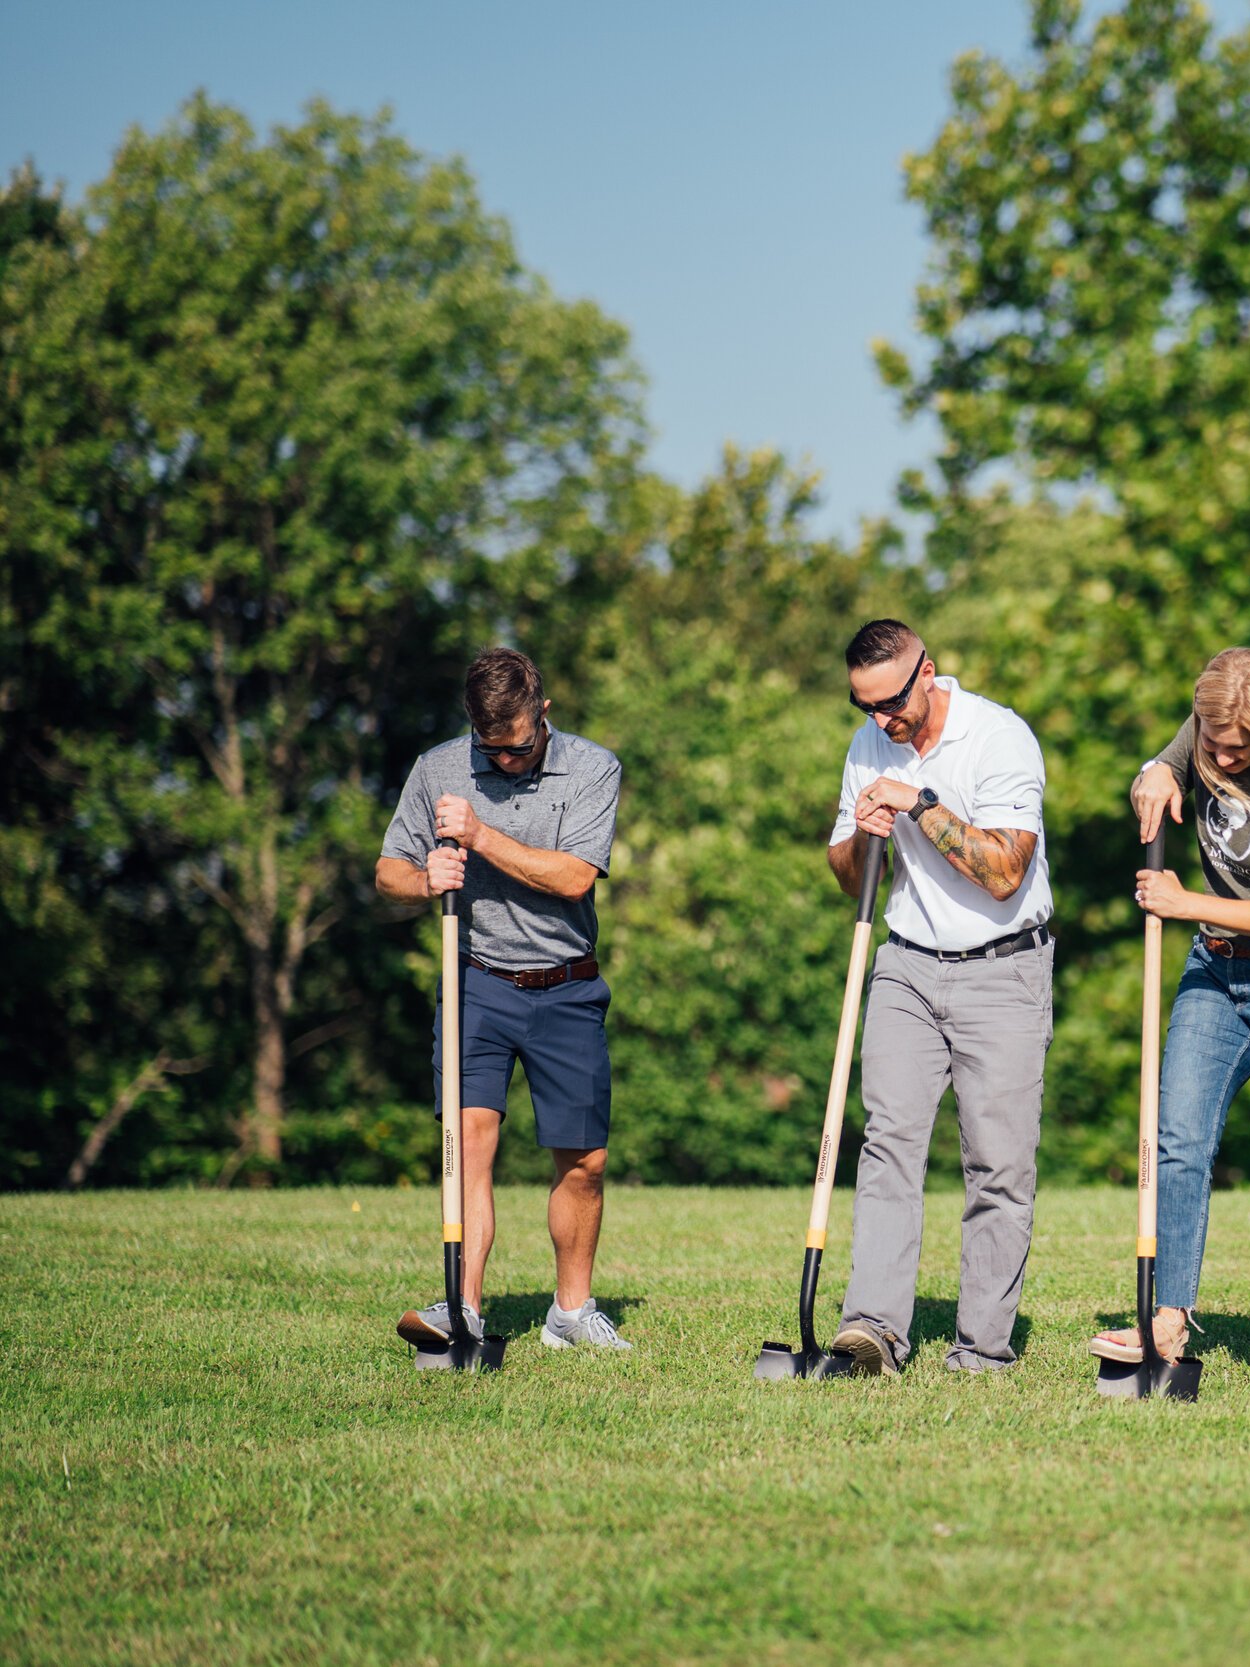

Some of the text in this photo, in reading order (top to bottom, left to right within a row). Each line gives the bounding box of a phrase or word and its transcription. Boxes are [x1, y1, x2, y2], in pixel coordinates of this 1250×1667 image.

[444, 1129, 453, 1177] YARDWORKS
[817, 1134, 831, 1183] YARDWORKS
[1140, 1138, 1149, 1189] YARDWORKS
